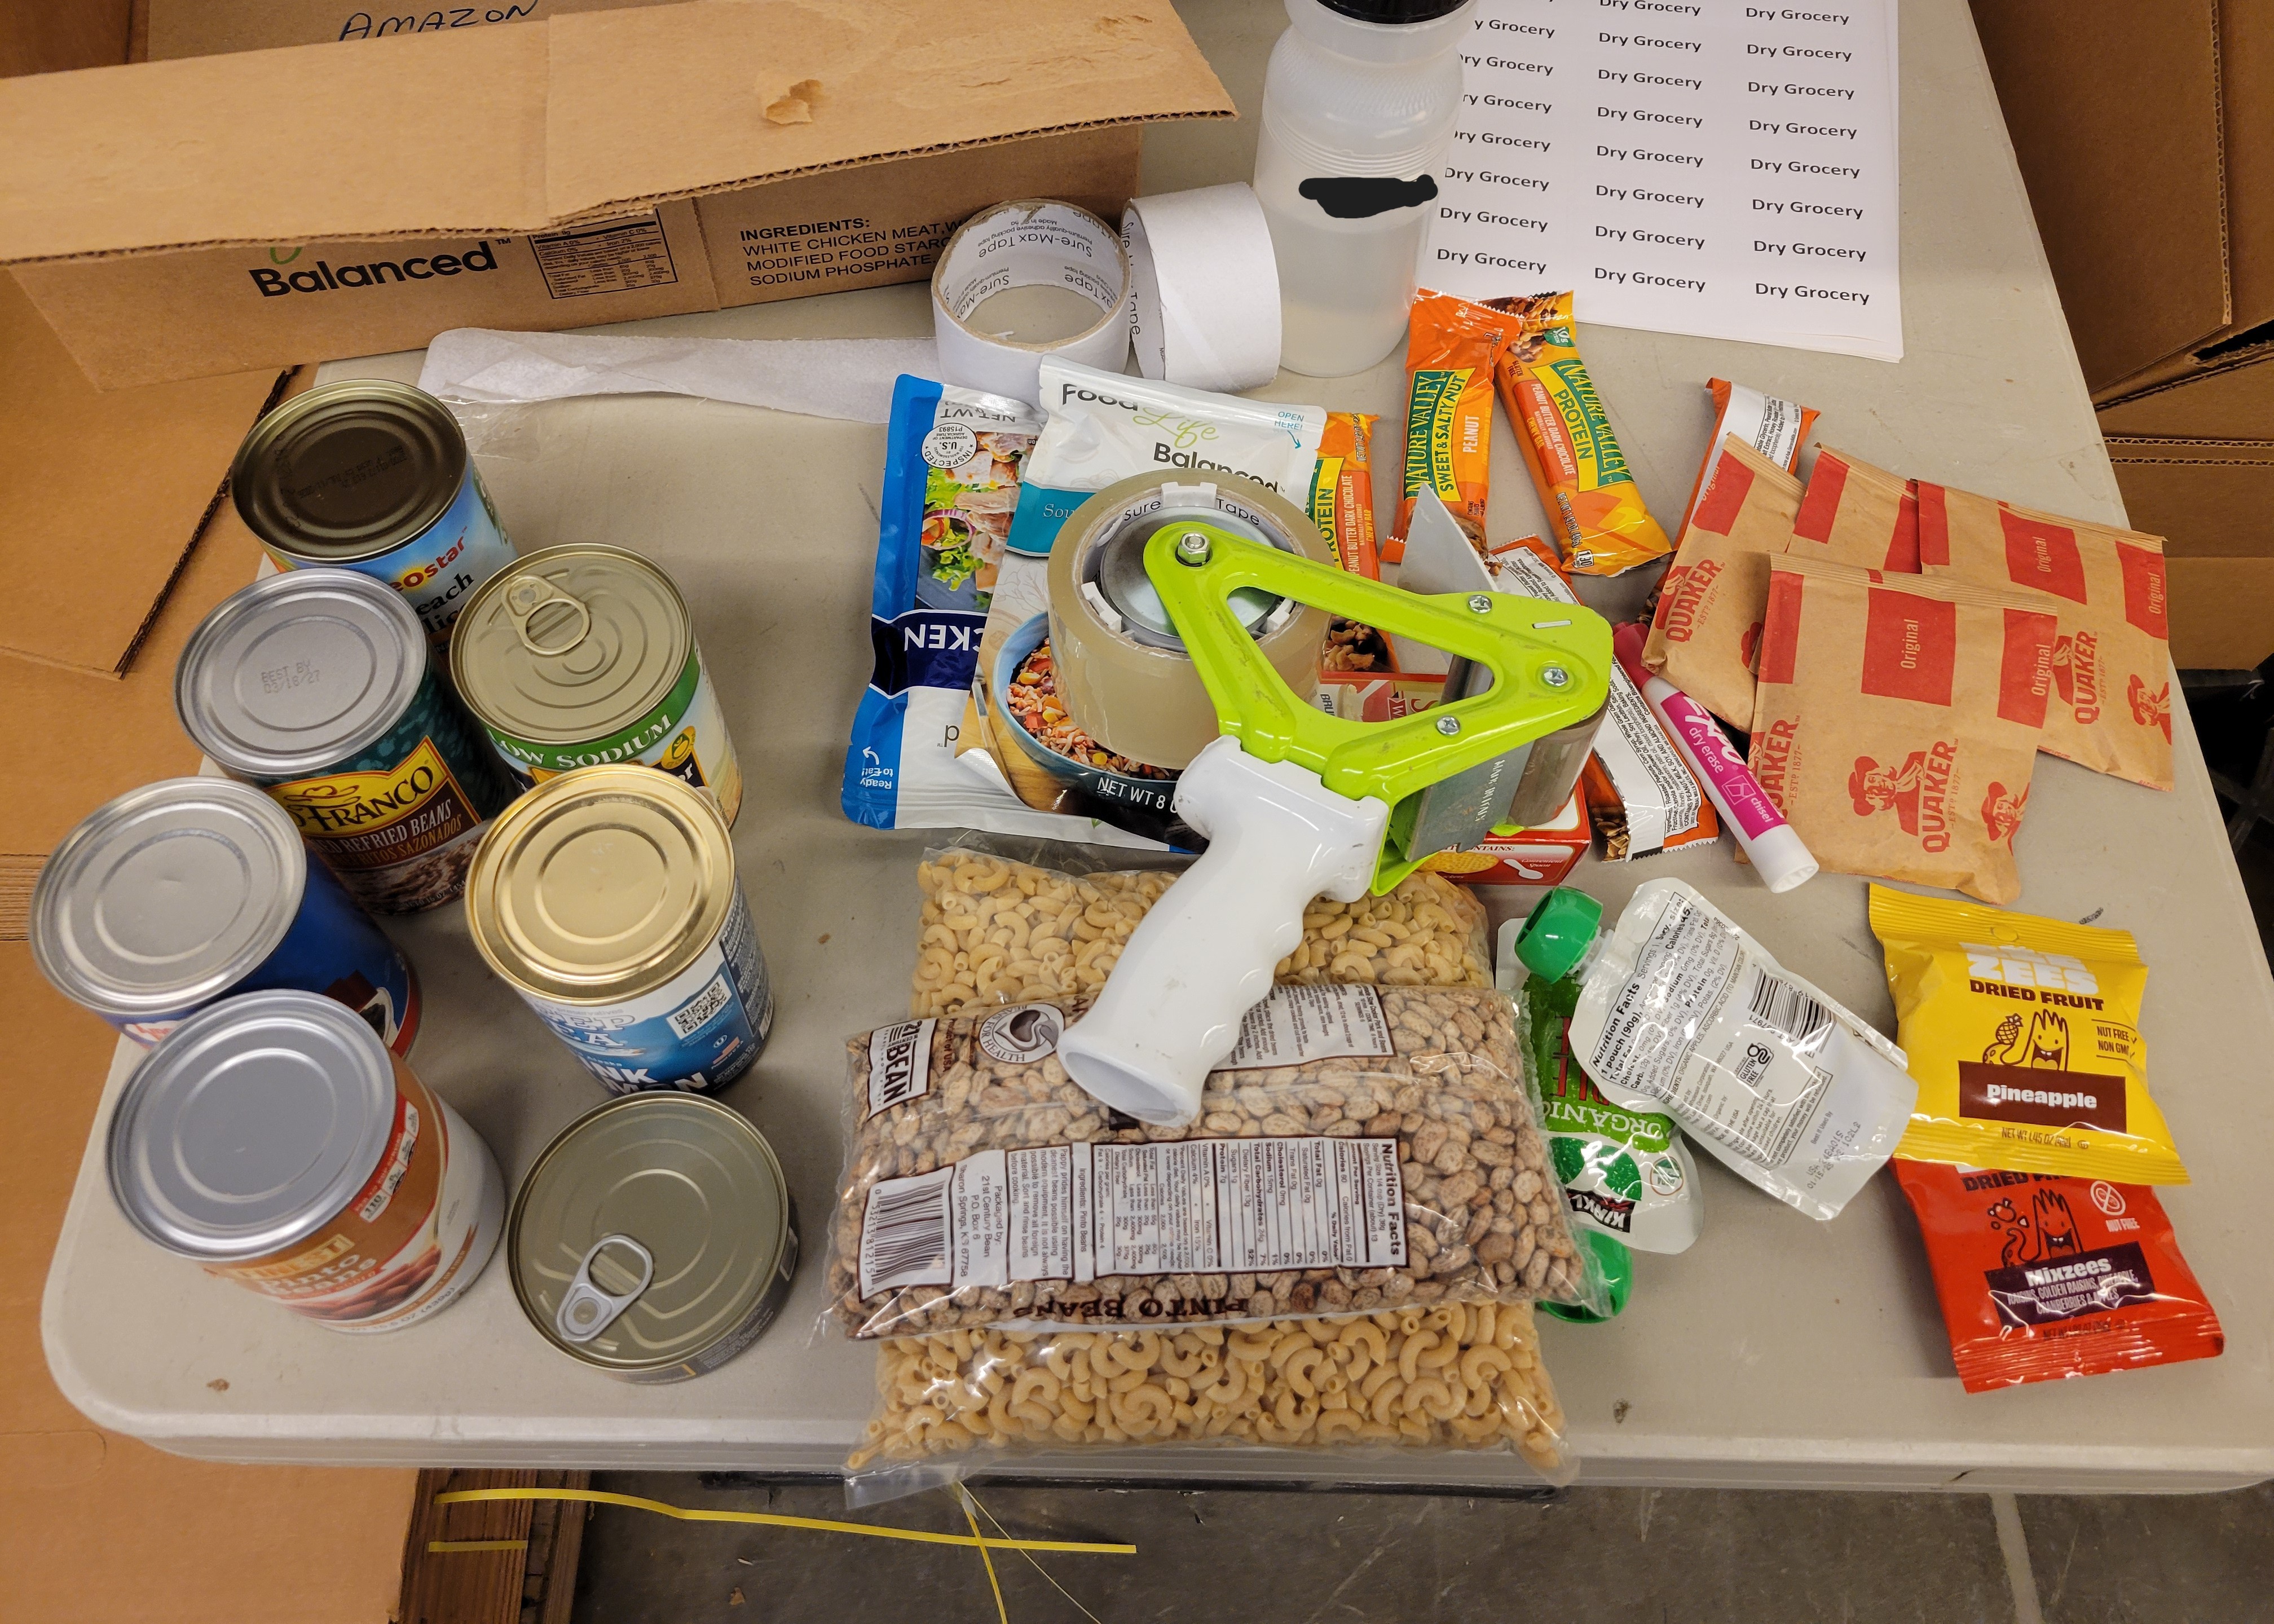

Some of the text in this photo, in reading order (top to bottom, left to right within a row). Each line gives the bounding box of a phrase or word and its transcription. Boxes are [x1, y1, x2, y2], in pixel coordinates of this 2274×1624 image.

[339, 0, 538, 41] AMAZON
[1488, 19, 1555, 39] Grocery
[1746, 7, 1849, 25] Dry Grocery
[1599, 32, 1702, 53] Dry Grocery
[1747, 44, 1852, 63] Dry Grocery
[1486, 56, 1554, 77] Grocery
[1598, 69, 1702, 90] Dry Grocery
[1748, 81, 1855, 100] Dry Grocery
[1483, 95, 1552, 114] Grocery
[1597, 107, 1703, 129] Dry Grocery
[1749, 120, 1857, 140] Dry Grocery
[1482, 133, 1551, 152] Grocery
[1597, 145, 1704, 168] Dry Grocery
[1751, 158, 1861, 179] Dry Grocery
[1444, 167, 1550, 192] Dry Grocery
[1596, 185, 1704, 209] Dry Grocery
[1752, 199, 1863, 220] Dry Grocery
[740, 218, 870, 241] INGREDIENTS:
[991, 227, 1015, 239] packing
[1440, 207, 1548, 233] Dry Grocery
[743, 241, 802, 256] WHITE
[807, 230, 886, 250] CHICKEN
[977, 236, 991, 247] tape
[979, 237, 1016, 258] Tape
[1019, 233, 1092, 258] Sure-Max
[1596, 226, 1706, 250] Dry Grocery
[1754, 240, 1867, 262] Dry Grocery
[248, 241, 498, 297] Balanced
[747, 245, 889, 271] MODIFIED FOOD
[750, 254, 936, 286] SODIUM PHOSPHATE.
[1437, 249, 1547, 275] Dry Grocery
[1594, 267, 1706, 293] Dry Grocery
[1755, 283, 1870, 306] Dry Grocery
[1506, 365, 1517, 378] FREE
[1512, 360, 1524, 377] GLUTEN
[1062, 383, 1138, 411] Food
[1447, 375, 1466, 403] NUT
[1132, 407, 1219, 449] Life
[1277, 411, 1305, 422] OPEN
[1435, 401, 1453, 440] SALTY
[1531, 383, 1576, 476] PEANUT BUTTER DARK CHOCOLATE
[1554, 391, 1594, 460] PROTEIN
[1558, 364, 1632, 483] NATURE VALLEY
[939, 441, 957, 450] U.S.
[1405, 375, 1447, 494] NATURE VALLEY
[1462, 414, 1479, 453] PEANUT
[924, 449, 973, 466] INSPECTED
[1435, 451, 1455, 492] SWEET
[1123, 501, 1161, 521] Sure
[1215, 498, 1261, 526] Tape
[2037, 537, 2052, 572] Original
[416, 573, 474, 615] each
[1666, 559, 1723, 642] QUAKER
[2148, 572, 2162, 615] Original
[1900, 619, 1919, 669] Original
[261, 665, 289, 684] BEST
[2031, 644, 2052, 696] Original
[2074, 630, 2098, 725] QUAKER
[556, 714, 672, 768] SODIUM
[1689, 727, 1724, 774] dry erase
[861, 767, 882, 777] Eat!
[1760, 719, 1799, 819] UAKER
[860, 778, 892, 789] Ready
[1097, 776, 1166, 809] NET WT 8
[1922, 740, 1958, 853] QUAKER
[309, 765, 434, 832] FRANCO
[1751, 797, 1775, 823] chisel
[342, 798, 452, 853] REFRIED BEANS
[1967, 953, 2099, 995] ZEES
[1607, 1040, 1625, 1070] pouch
[1665, 920, 1686, 951] Calories
[1969, 979, 2104, 1011] DRIED FRUIT
[1592, 983, 1641, 1069] Nutrition Facts
[2096, 1026, 2130, 1042] NUT FREE
[982, 1038, 1026, 1062] HEALTH
[2097, 1039, 2114, 1052] NON
[883, 1042, 909, 1104] BEAN
[1739, 1057, 1757, 1082] GLUTEN
[1746, 1070, 1760, 1085] FREE
[1986, 1083, 2097, 1109] Pineapple
[1276, 1141, 1285, 1189] Cholesterol
[1337, 1141, 1346, 1175] Calories
[1078, 1168, 1087, 1210] Ingredients:
[1255, 1163, 1263, 1227] Carbohydrates
[1962, 1172, 2029, 1192] DRIED
[994, 1185, 1004, 1229] Packaged
[1382, 1143, 1400, 1256] Nutrition Facts
[972, 1213, 980, 1231] Box
[982, 1195, 993, 1257] Century Bean
[2025, 1257, 2112, 1287] Mixzees
